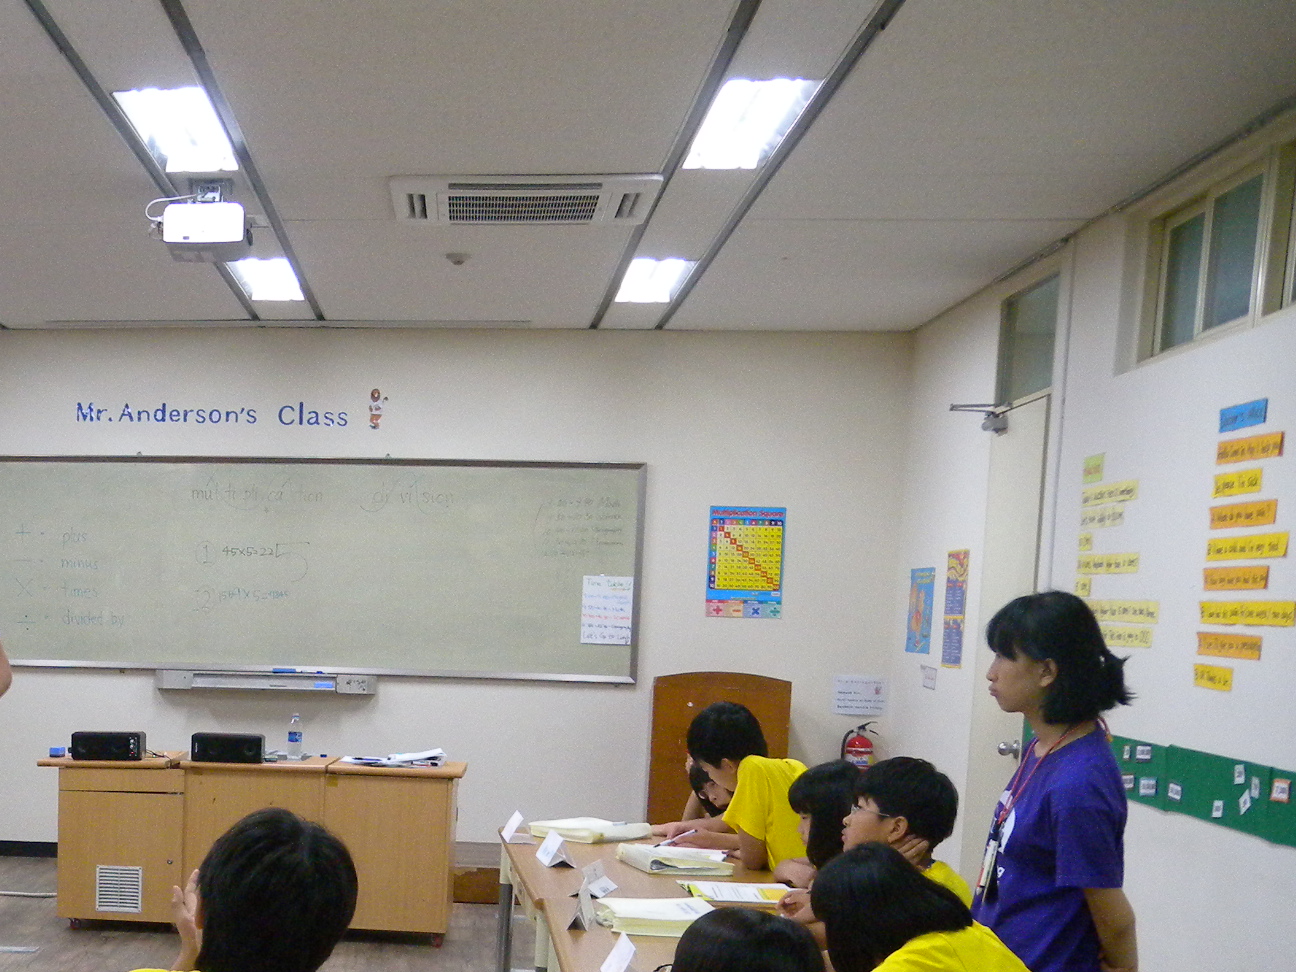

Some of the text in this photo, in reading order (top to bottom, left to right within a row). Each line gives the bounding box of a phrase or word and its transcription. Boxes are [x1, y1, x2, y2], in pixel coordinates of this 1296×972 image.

[76, 402, 349, 427] Mr. Anderson's Class
